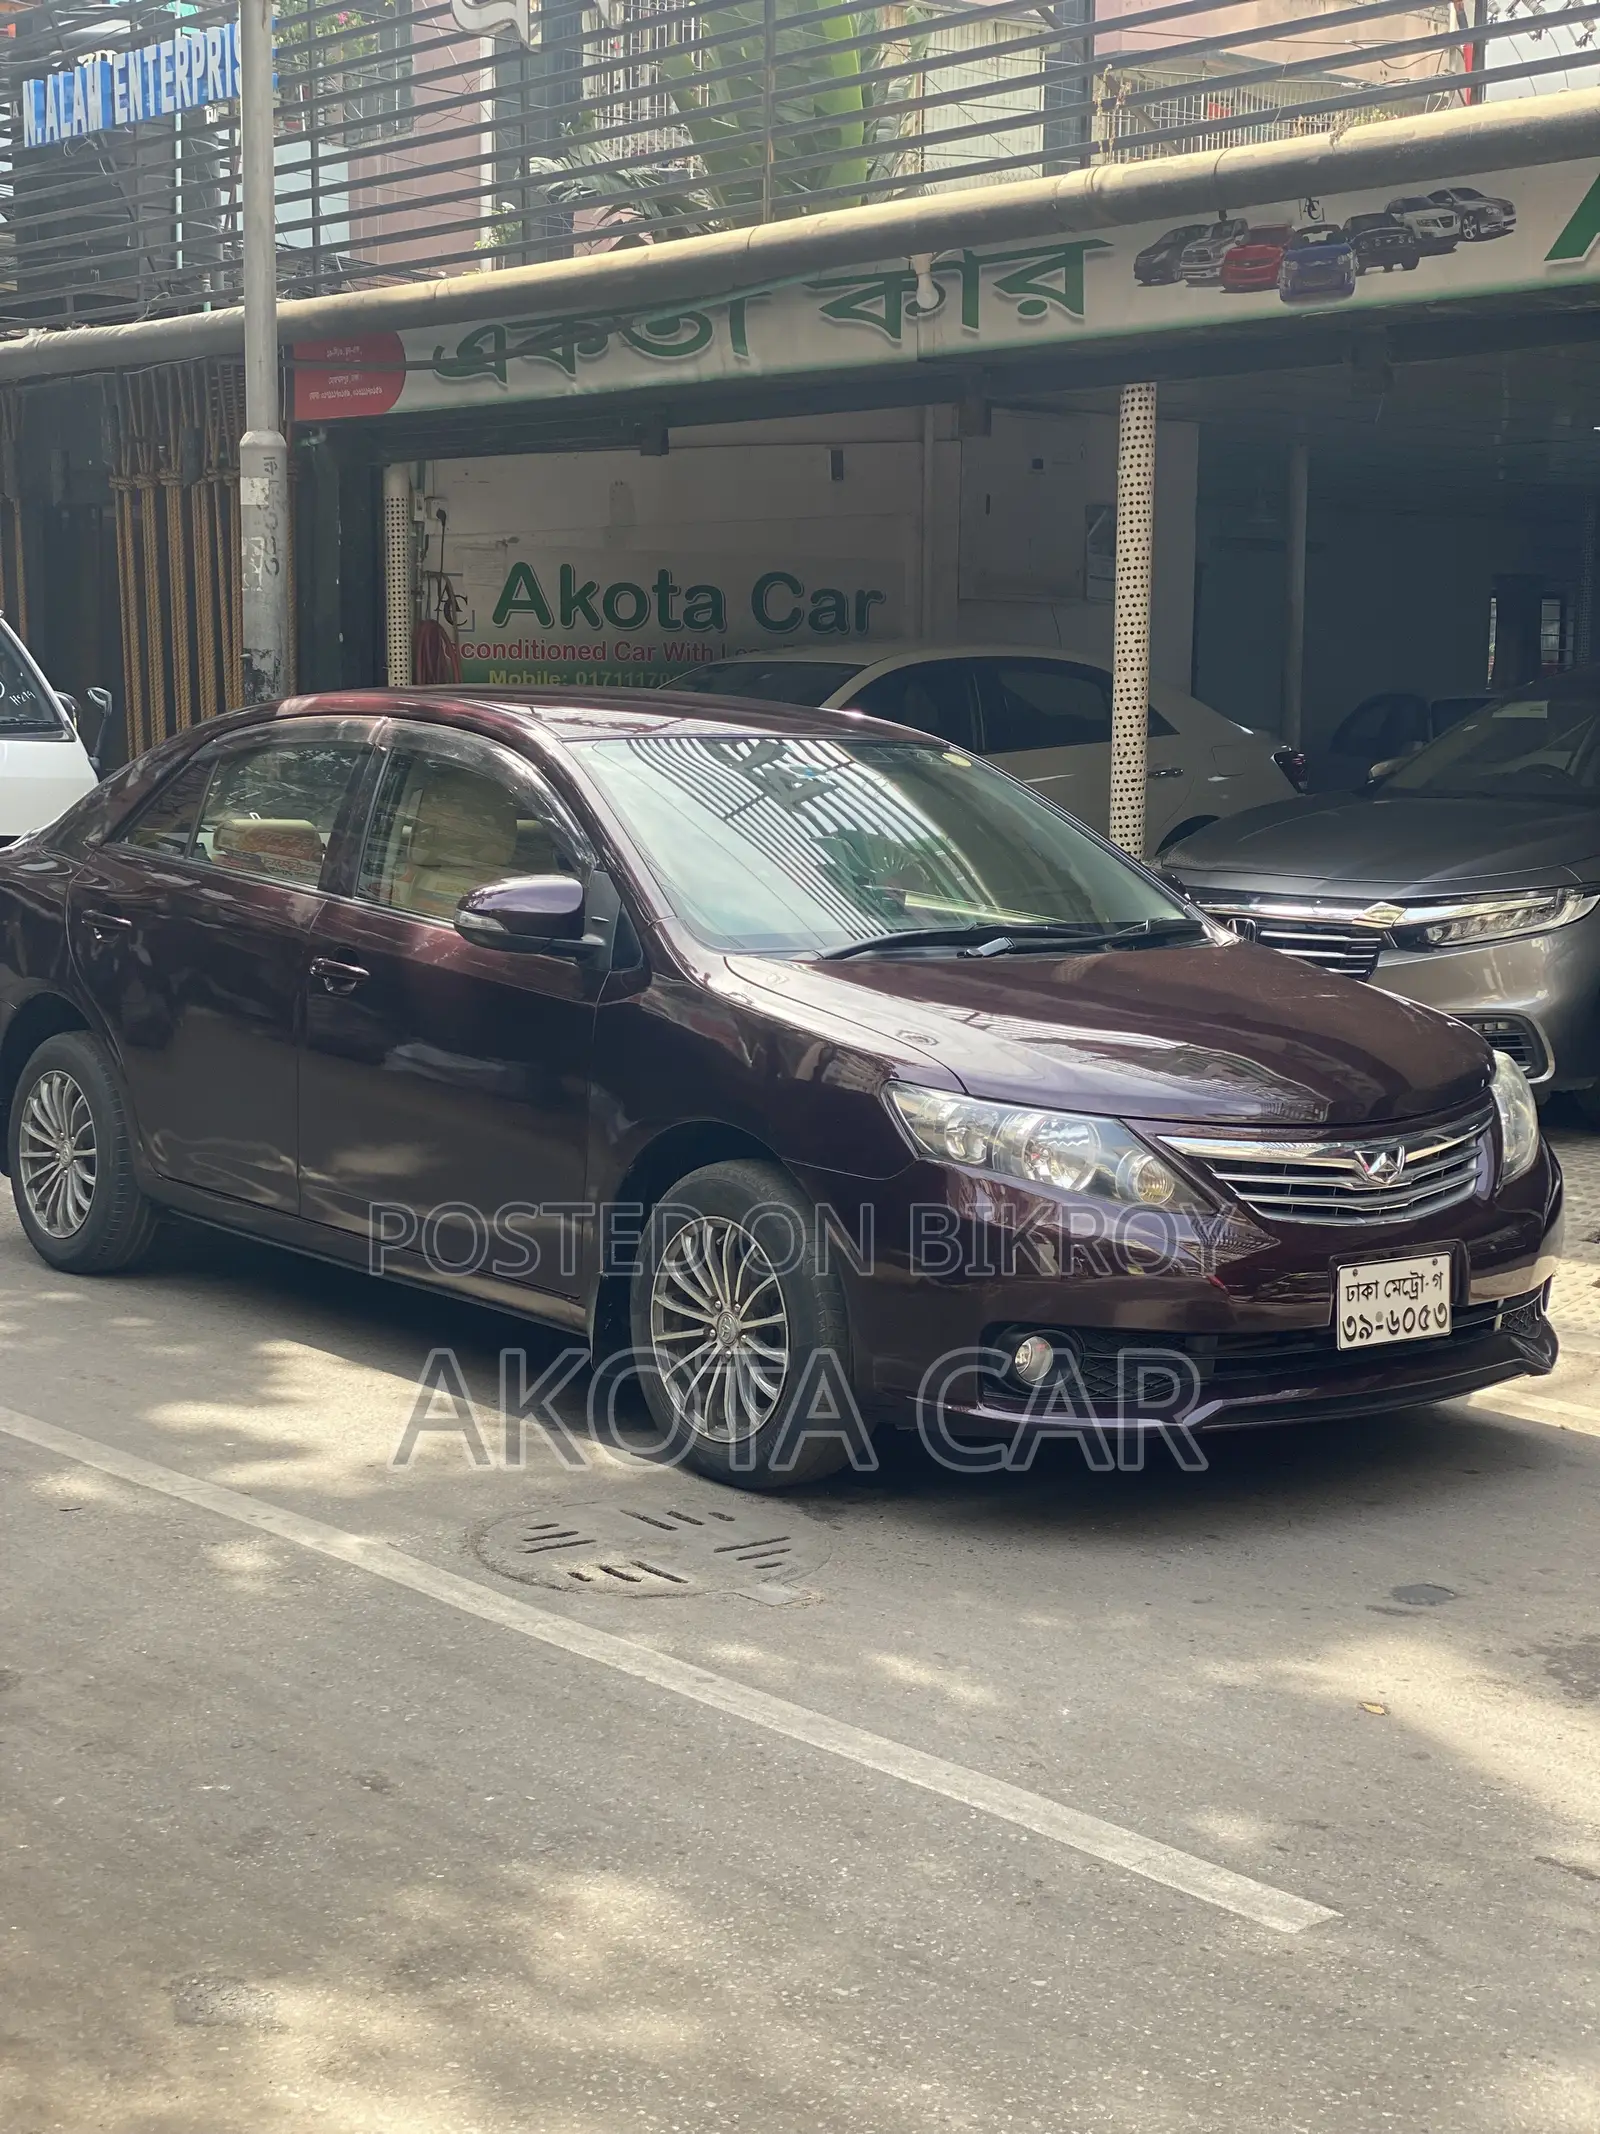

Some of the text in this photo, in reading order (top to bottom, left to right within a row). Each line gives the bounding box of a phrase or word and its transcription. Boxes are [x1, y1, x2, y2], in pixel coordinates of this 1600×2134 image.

[113, 18, 243, 125] ENTERPRI
[802, 238, 1115, 344] কার
[491, 560, 887, 634] Akota Car
[613, 640, 656, 663] Car
[663, 641, 713, 663] With
[488, 669, 568, 688] Mobile:
[1346, 1280, 1379, 1302] ঢাকা
[1342, 1302, 1448, 1342] ৩৯-৬০৫৩
